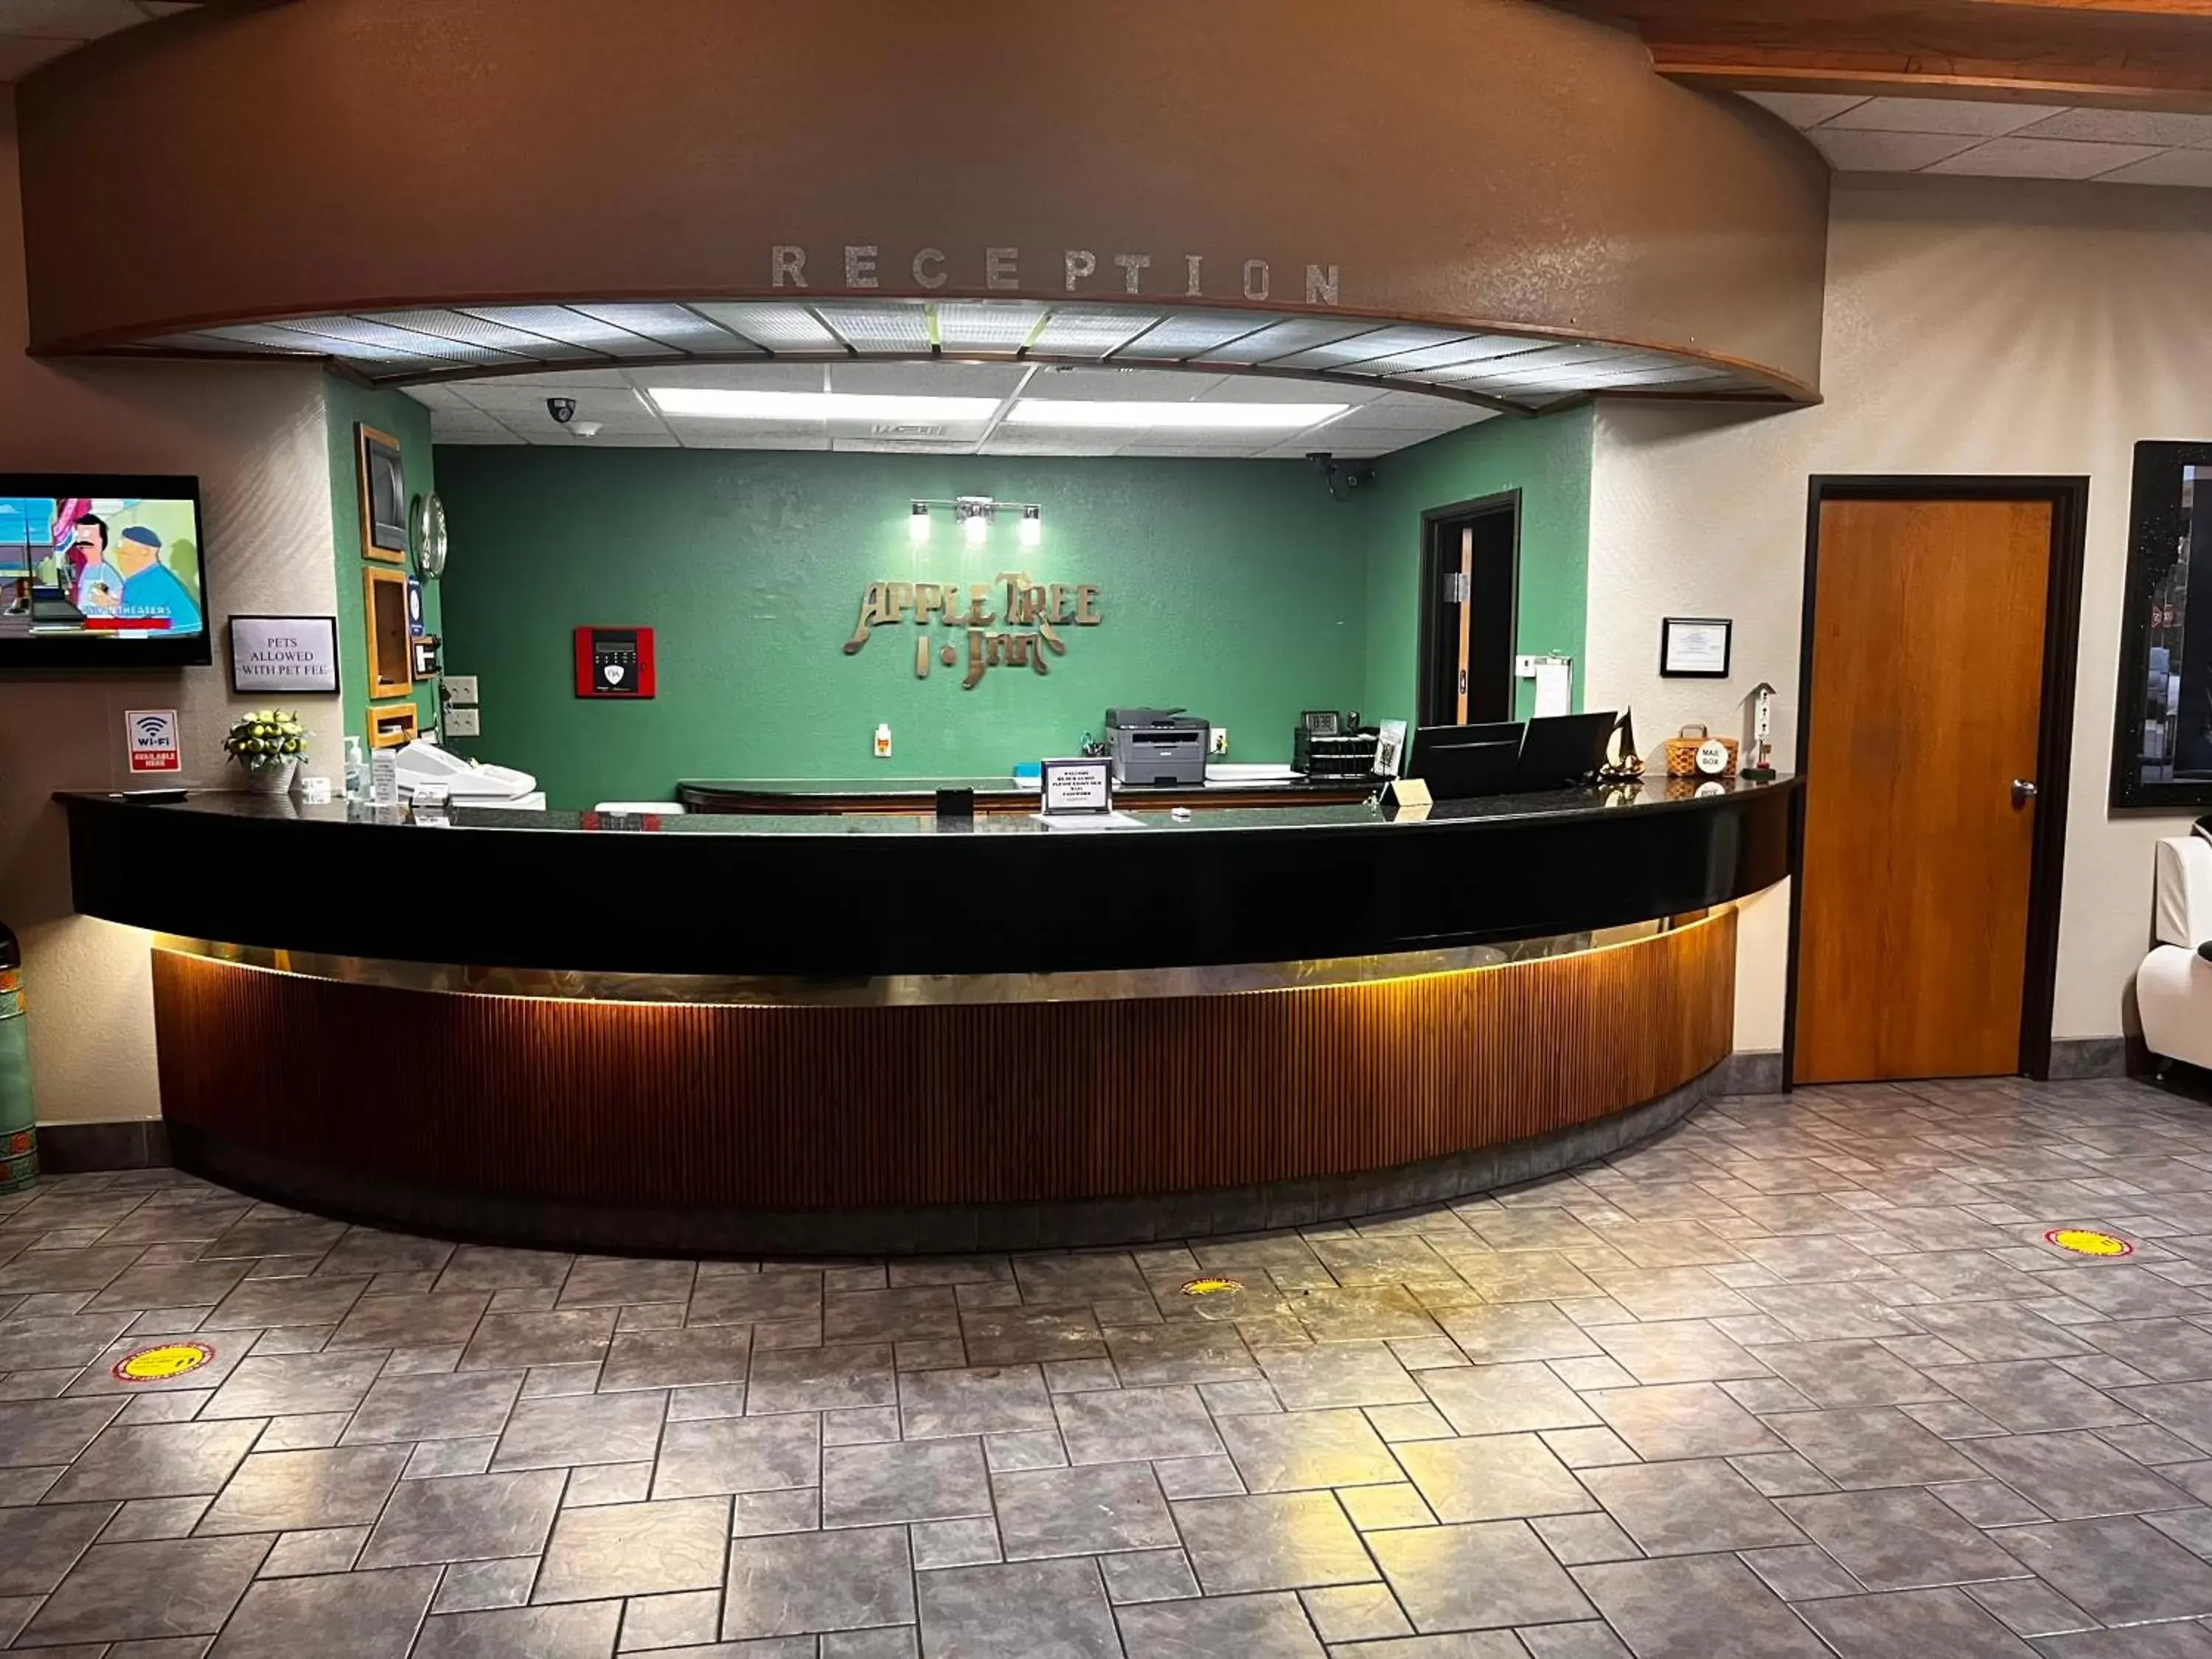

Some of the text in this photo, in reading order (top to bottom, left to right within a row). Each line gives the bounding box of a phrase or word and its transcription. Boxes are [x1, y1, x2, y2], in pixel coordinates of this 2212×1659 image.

[771, 244, 1339, 306] RECEPTION
[267, 637, 298, 648] PETS
[250, 651, 314, 662] ALLOWED
[242, 664, 275, 675] WITH
[279, 664, 301, 675] PET
